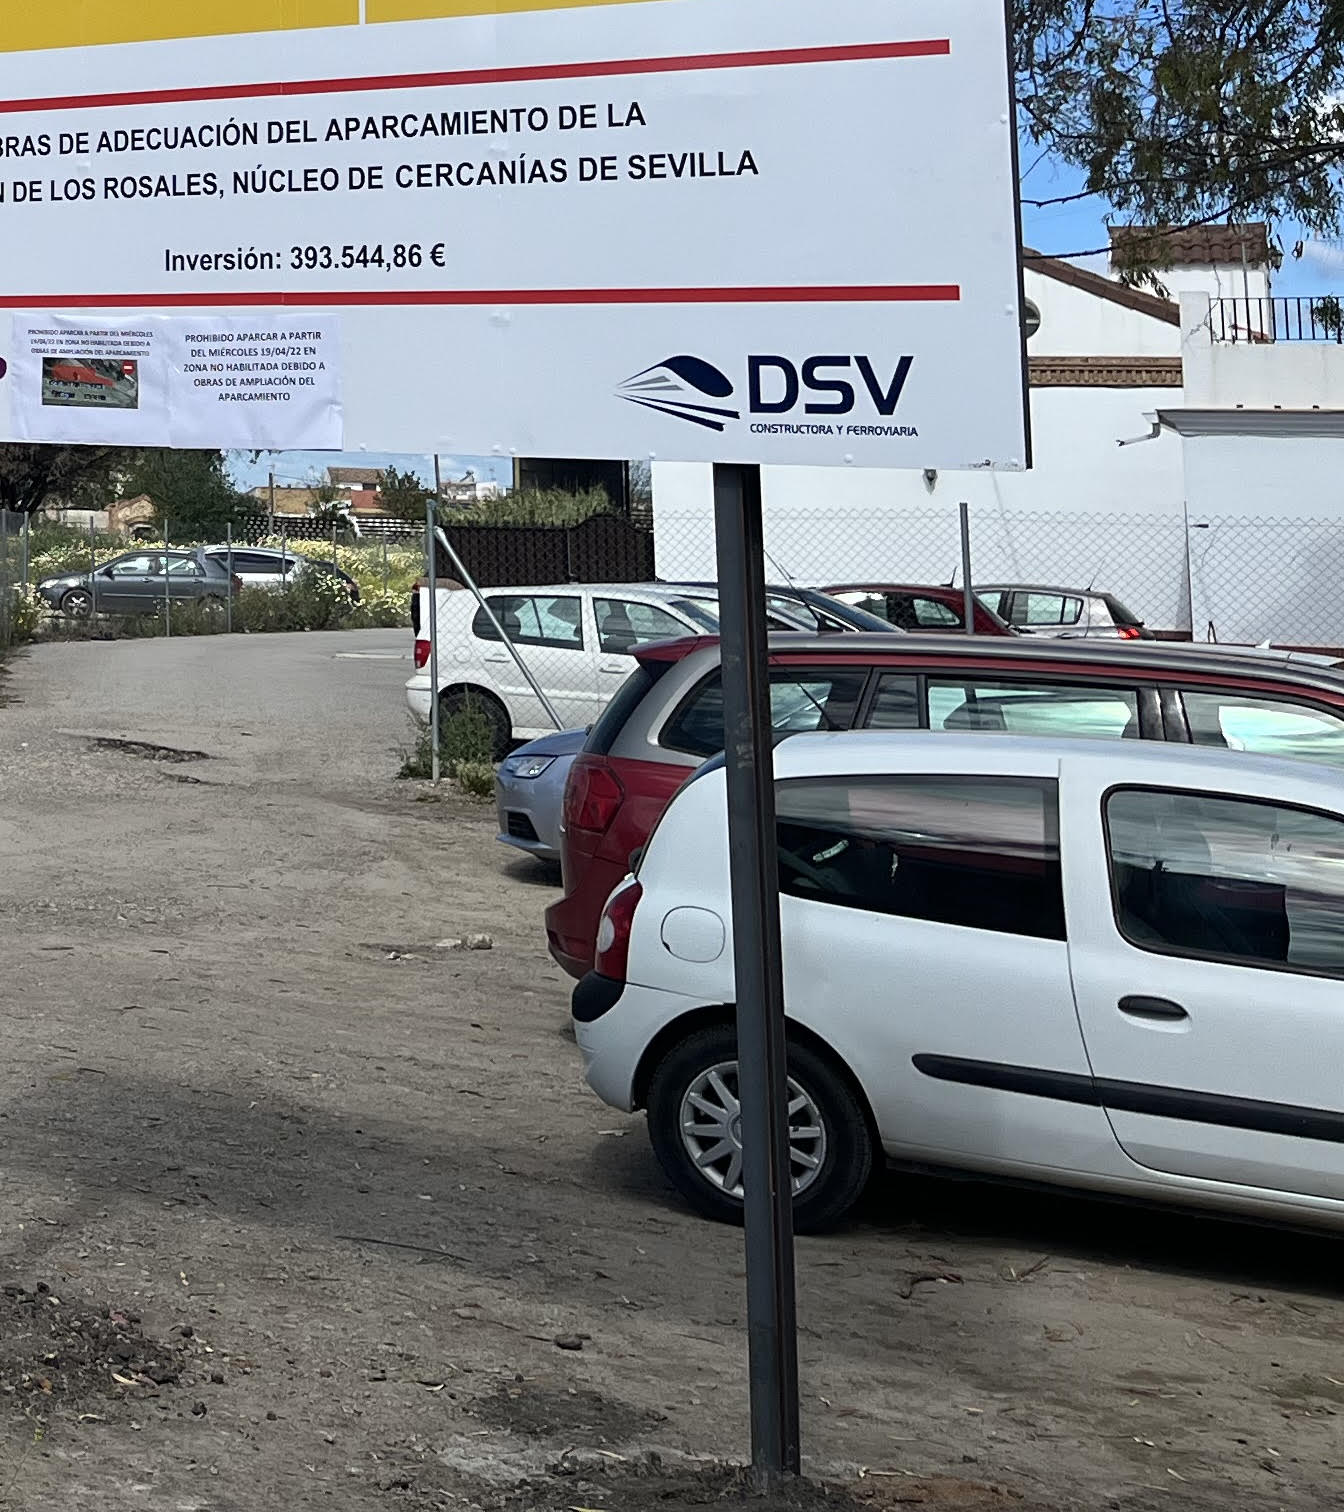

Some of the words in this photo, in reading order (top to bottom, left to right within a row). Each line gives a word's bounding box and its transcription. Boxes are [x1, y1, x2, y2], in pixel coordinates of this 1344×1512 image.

[59, 132, 89, 155] DE
[96, 117, 258, 153] ADECUACIÓN
[267, 120, 317, 144] DEL
[325, 106, 548, 141] APARCAMIENTO
[558, 104, 597, 130] DE
[608, 101, 646, 127] LA
[12, 180, 42, 203] DE
[50, 178, 96, 201] LOS
[103, 173, 224, 199] ROSALES,
[233, 163, 339, 194] NÚCLEO
[348, 166, 383, 190] DE
[395, 153, 568, 189] CERCANÍAS
[579, 156, 618, 182] DE
[628, 150, 759, 180] SEVILLA
[165, 247, 282, 272] Inversión:
[290, 243, 422, 272] 393.544,86
[430, 243, 446, 268] €
[185, 333, 234, 343] PROHIBIDO
[236, 332, 278, 342] APARCAR
[280, 332, 287, 340] A
[289, 331, 322, 340] PARTIR
[191, 349, 206, 358] DEL
[208, 347, 259, 357] MIÉRCOLES
[261, 346, 302, 358] 19/04/22
[304, 347, 316, 356] EN
[184, 363, 208, 373] ZONA
[210, 363, 224, 372] NO
[226, 362, 279, 372] HABILITADA
[281, 361, 317, 371] DEBIDO
[318, 361, 326, 370] A
[194, 378, 223, 387] OBRAS
[225, 378, 237, 387] DE
[239, 375, 296, 387] AMPLIACIÓN
[298, 377, 315, 386] DEL
[748, 355, 914, 416] DSV
[218, 392, 291, 401] APARCAMIENTO
[750, 423, 833, 435] CONSTRUCTORA
[836, 425, 843, 435] Y
[846, 425, 918, 437] FERROVIARIA
